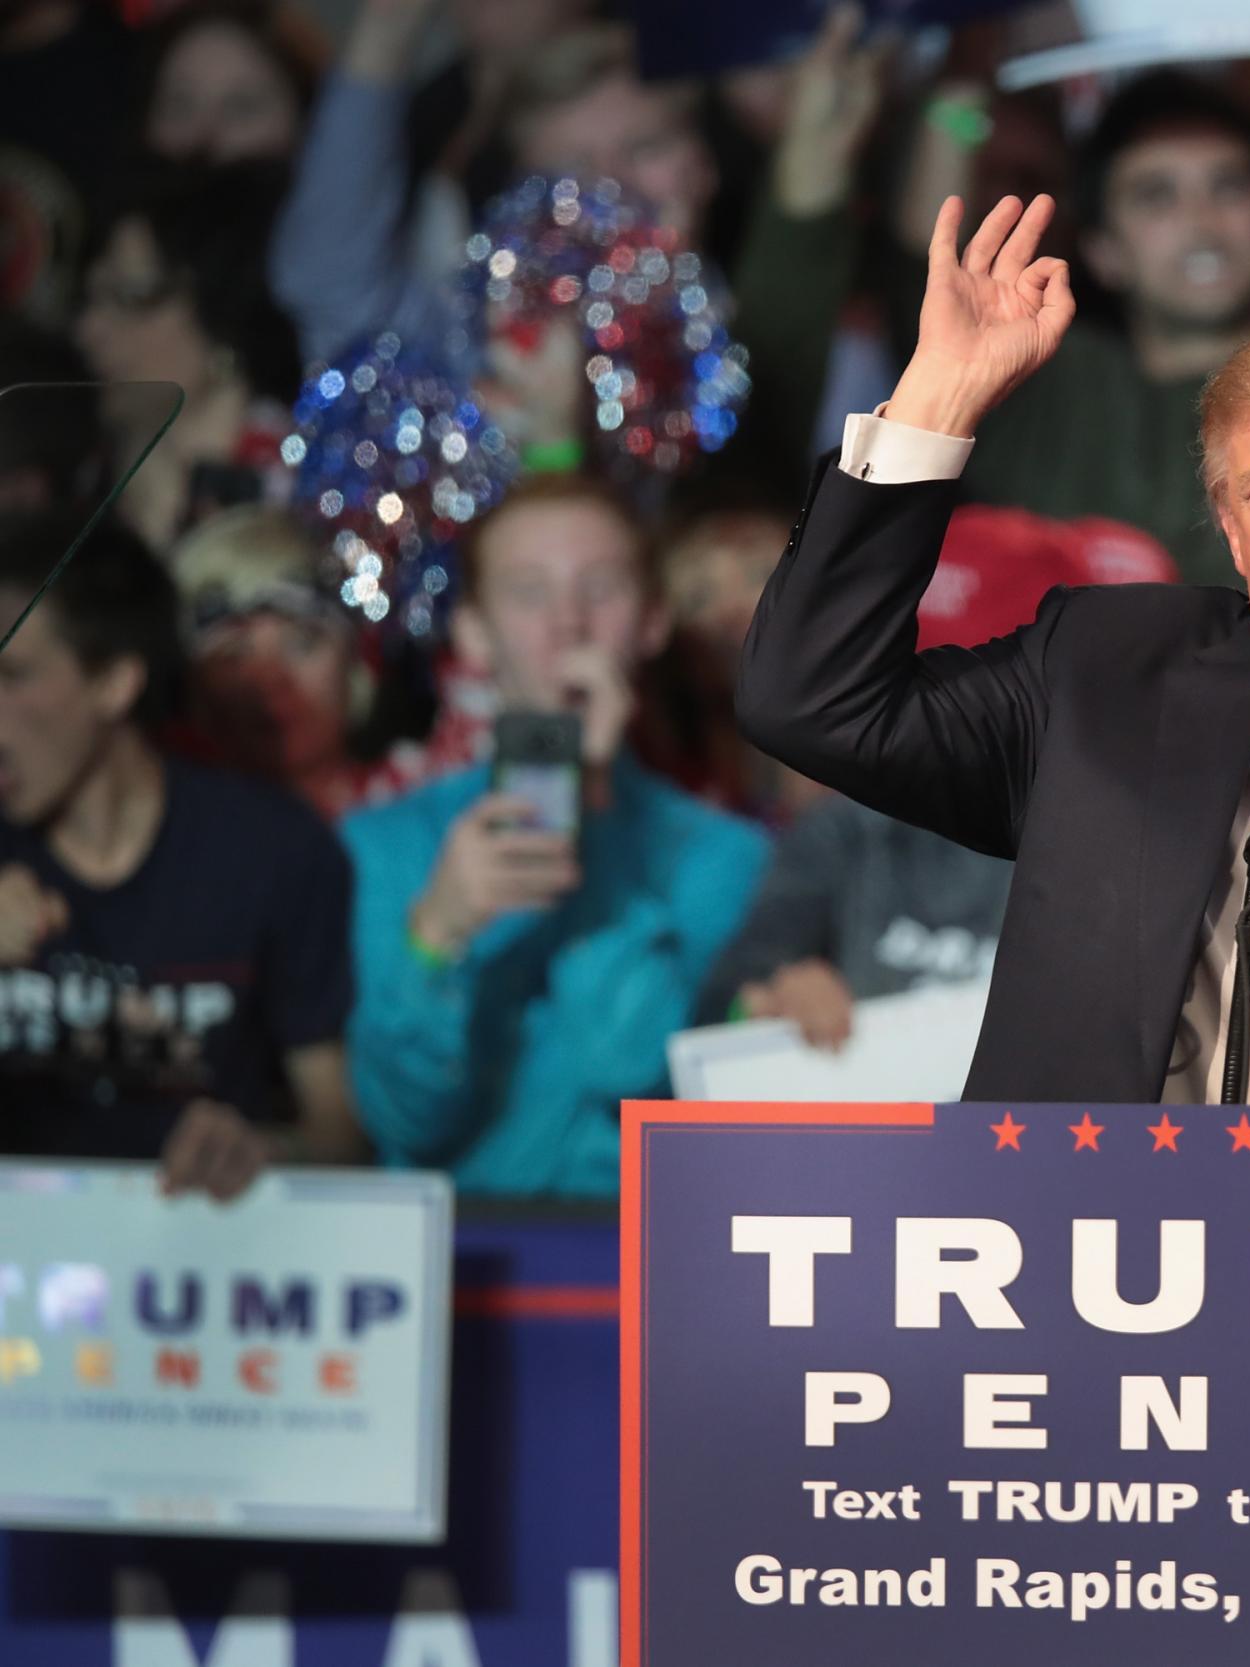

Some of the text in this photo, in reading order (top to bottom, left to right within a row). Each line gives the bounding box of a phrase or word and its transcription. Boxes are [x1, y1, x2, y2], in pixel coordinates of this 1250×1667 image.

[803, 1481, 921, 1520] Text
[948, 1480, 1199, 1522] TRUMP
[734, 1554, 946, 1606] Grand
[976, 1558, 1240, 1622] Rapids,
